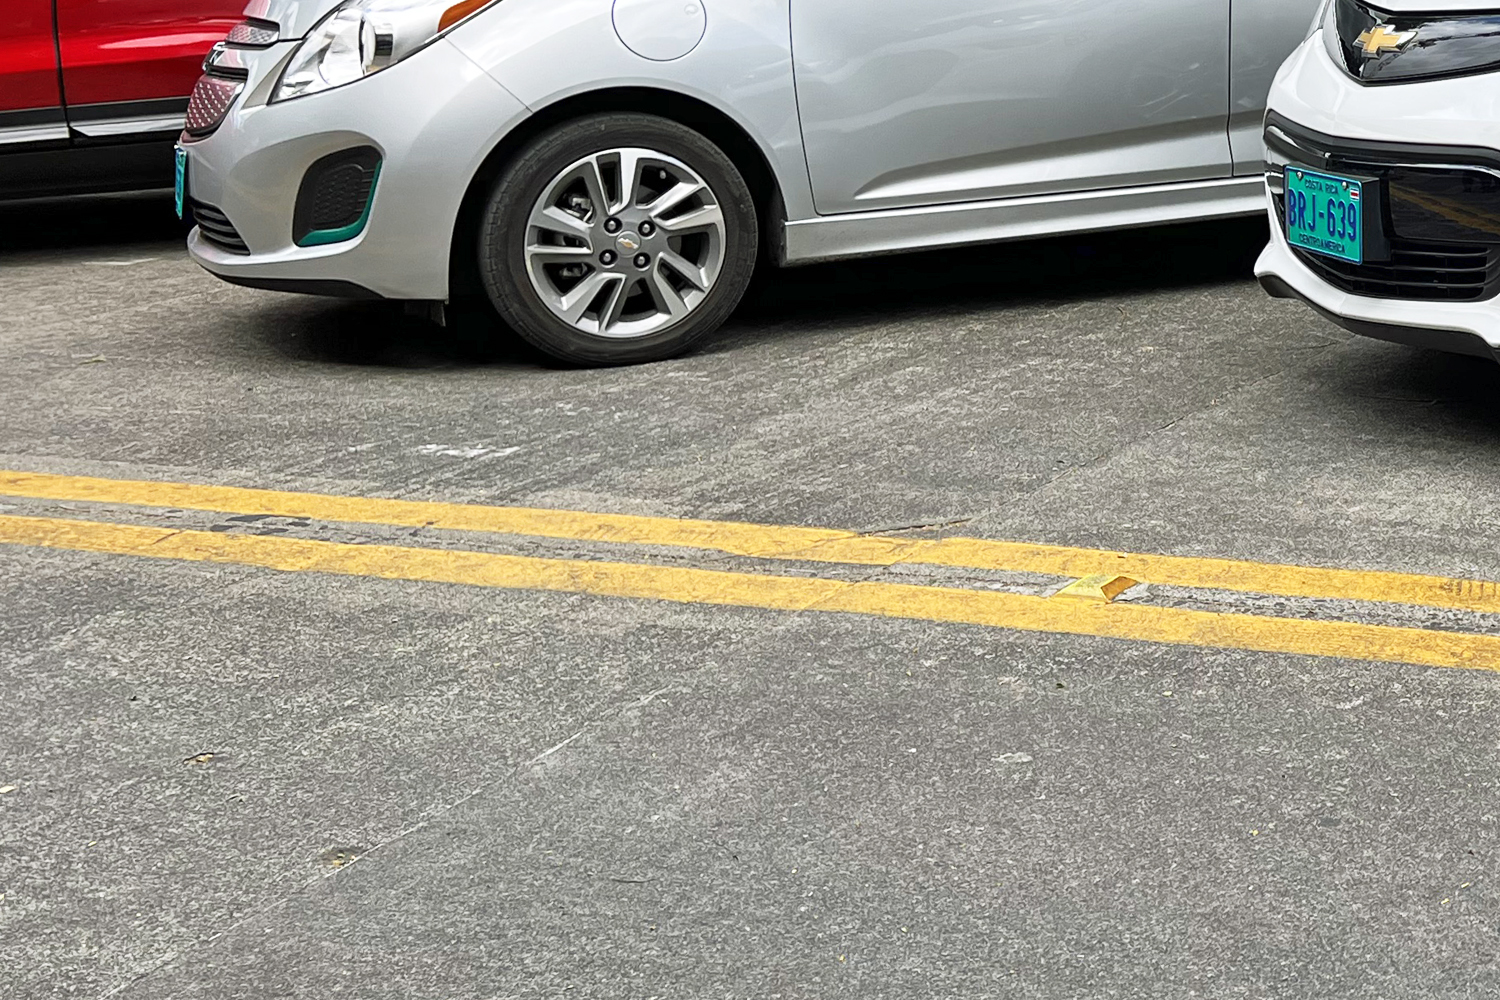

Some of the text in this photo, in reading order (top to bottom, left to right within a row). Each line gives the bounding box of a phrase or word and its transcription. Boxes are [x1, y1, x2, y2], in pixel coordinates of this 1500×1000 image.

[1304, 178, 1339, 195] COSTA RICA
[1288, 187, 1357, 242] BRJ-639
